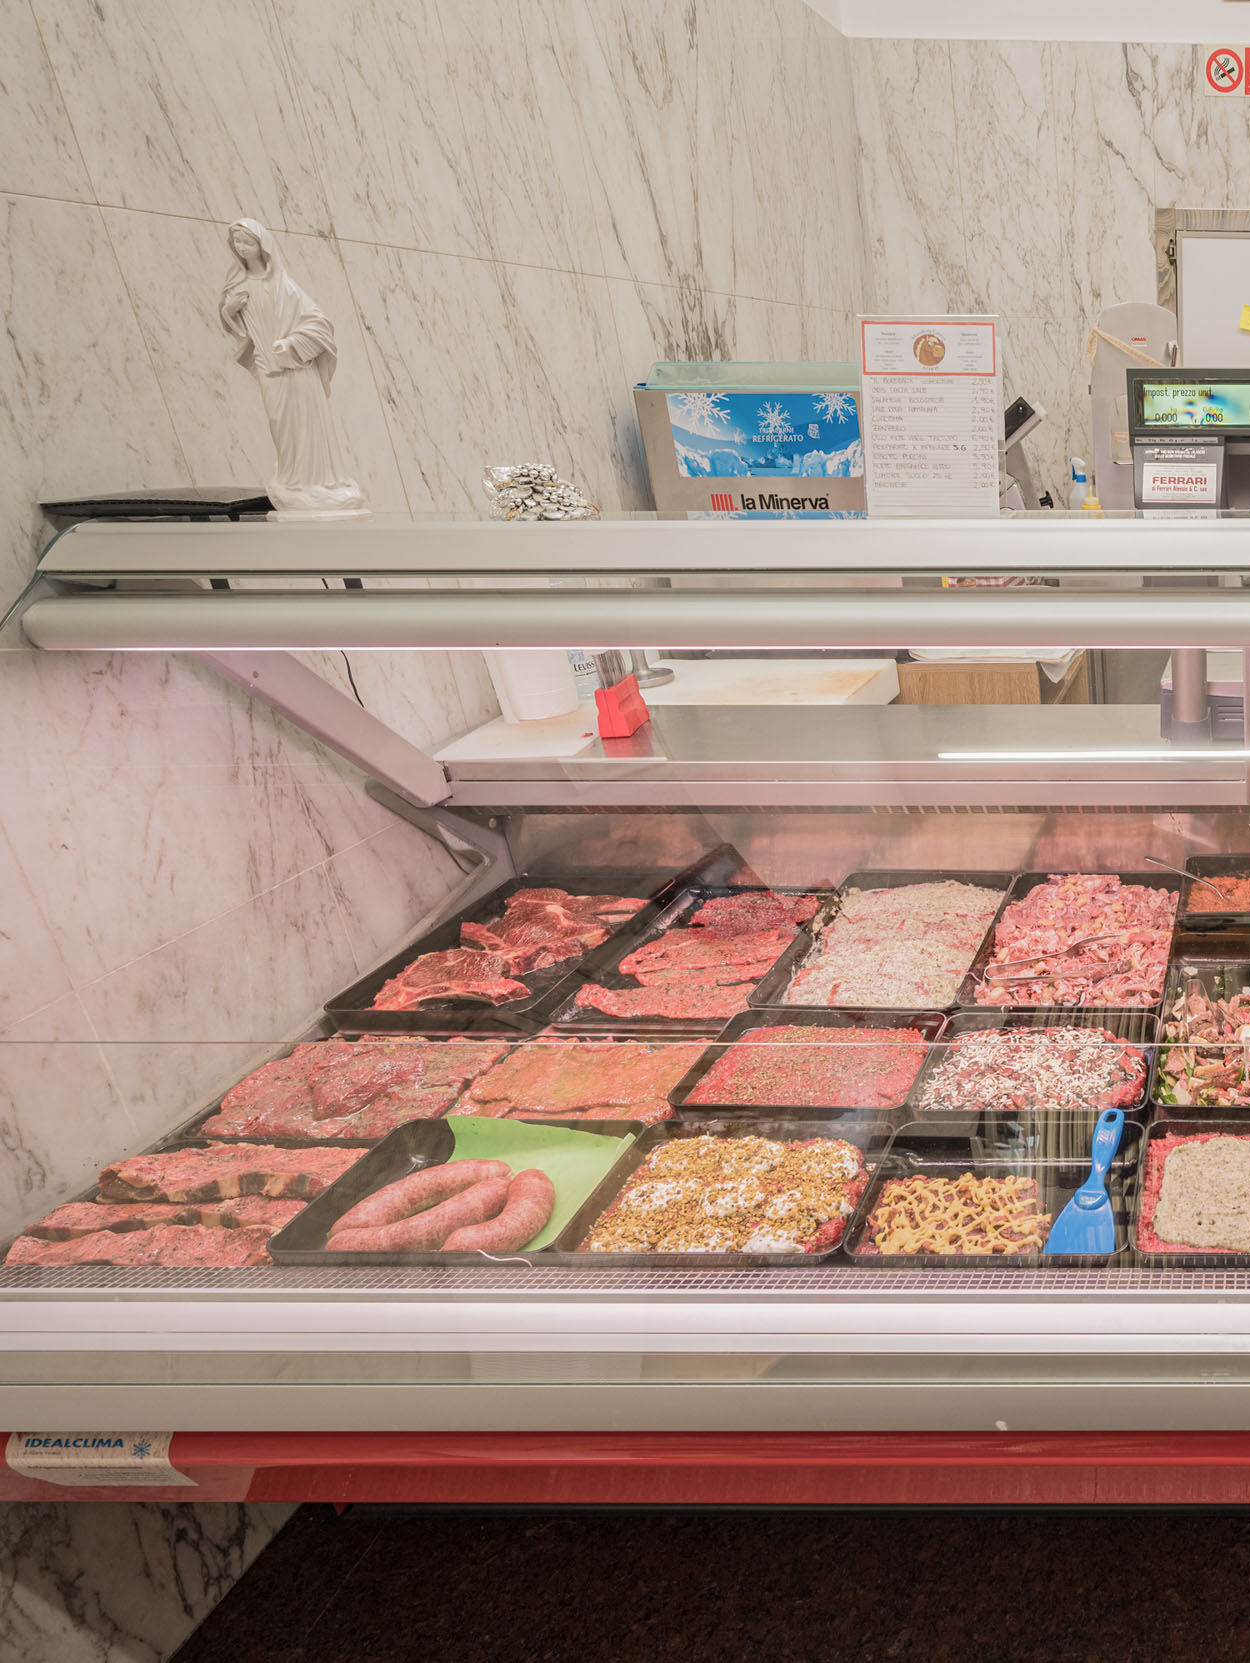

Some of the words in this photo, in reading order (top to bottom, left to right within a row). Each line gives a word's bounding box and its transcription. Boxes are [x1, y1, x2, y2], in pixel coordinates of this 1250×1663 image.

[1172, 388, 1196, 400] prezzo
[1205, 412, 1224, 423] 0,00
[752, 434, 804, 443] REFRIGERATO
[1152, 476, 1207, 485] FERRARI
[740, 494, 756, 510] la
[759, 494, 829, 510] Minerva
[24, 1438, 124, 1449] IDEALCLIMA
